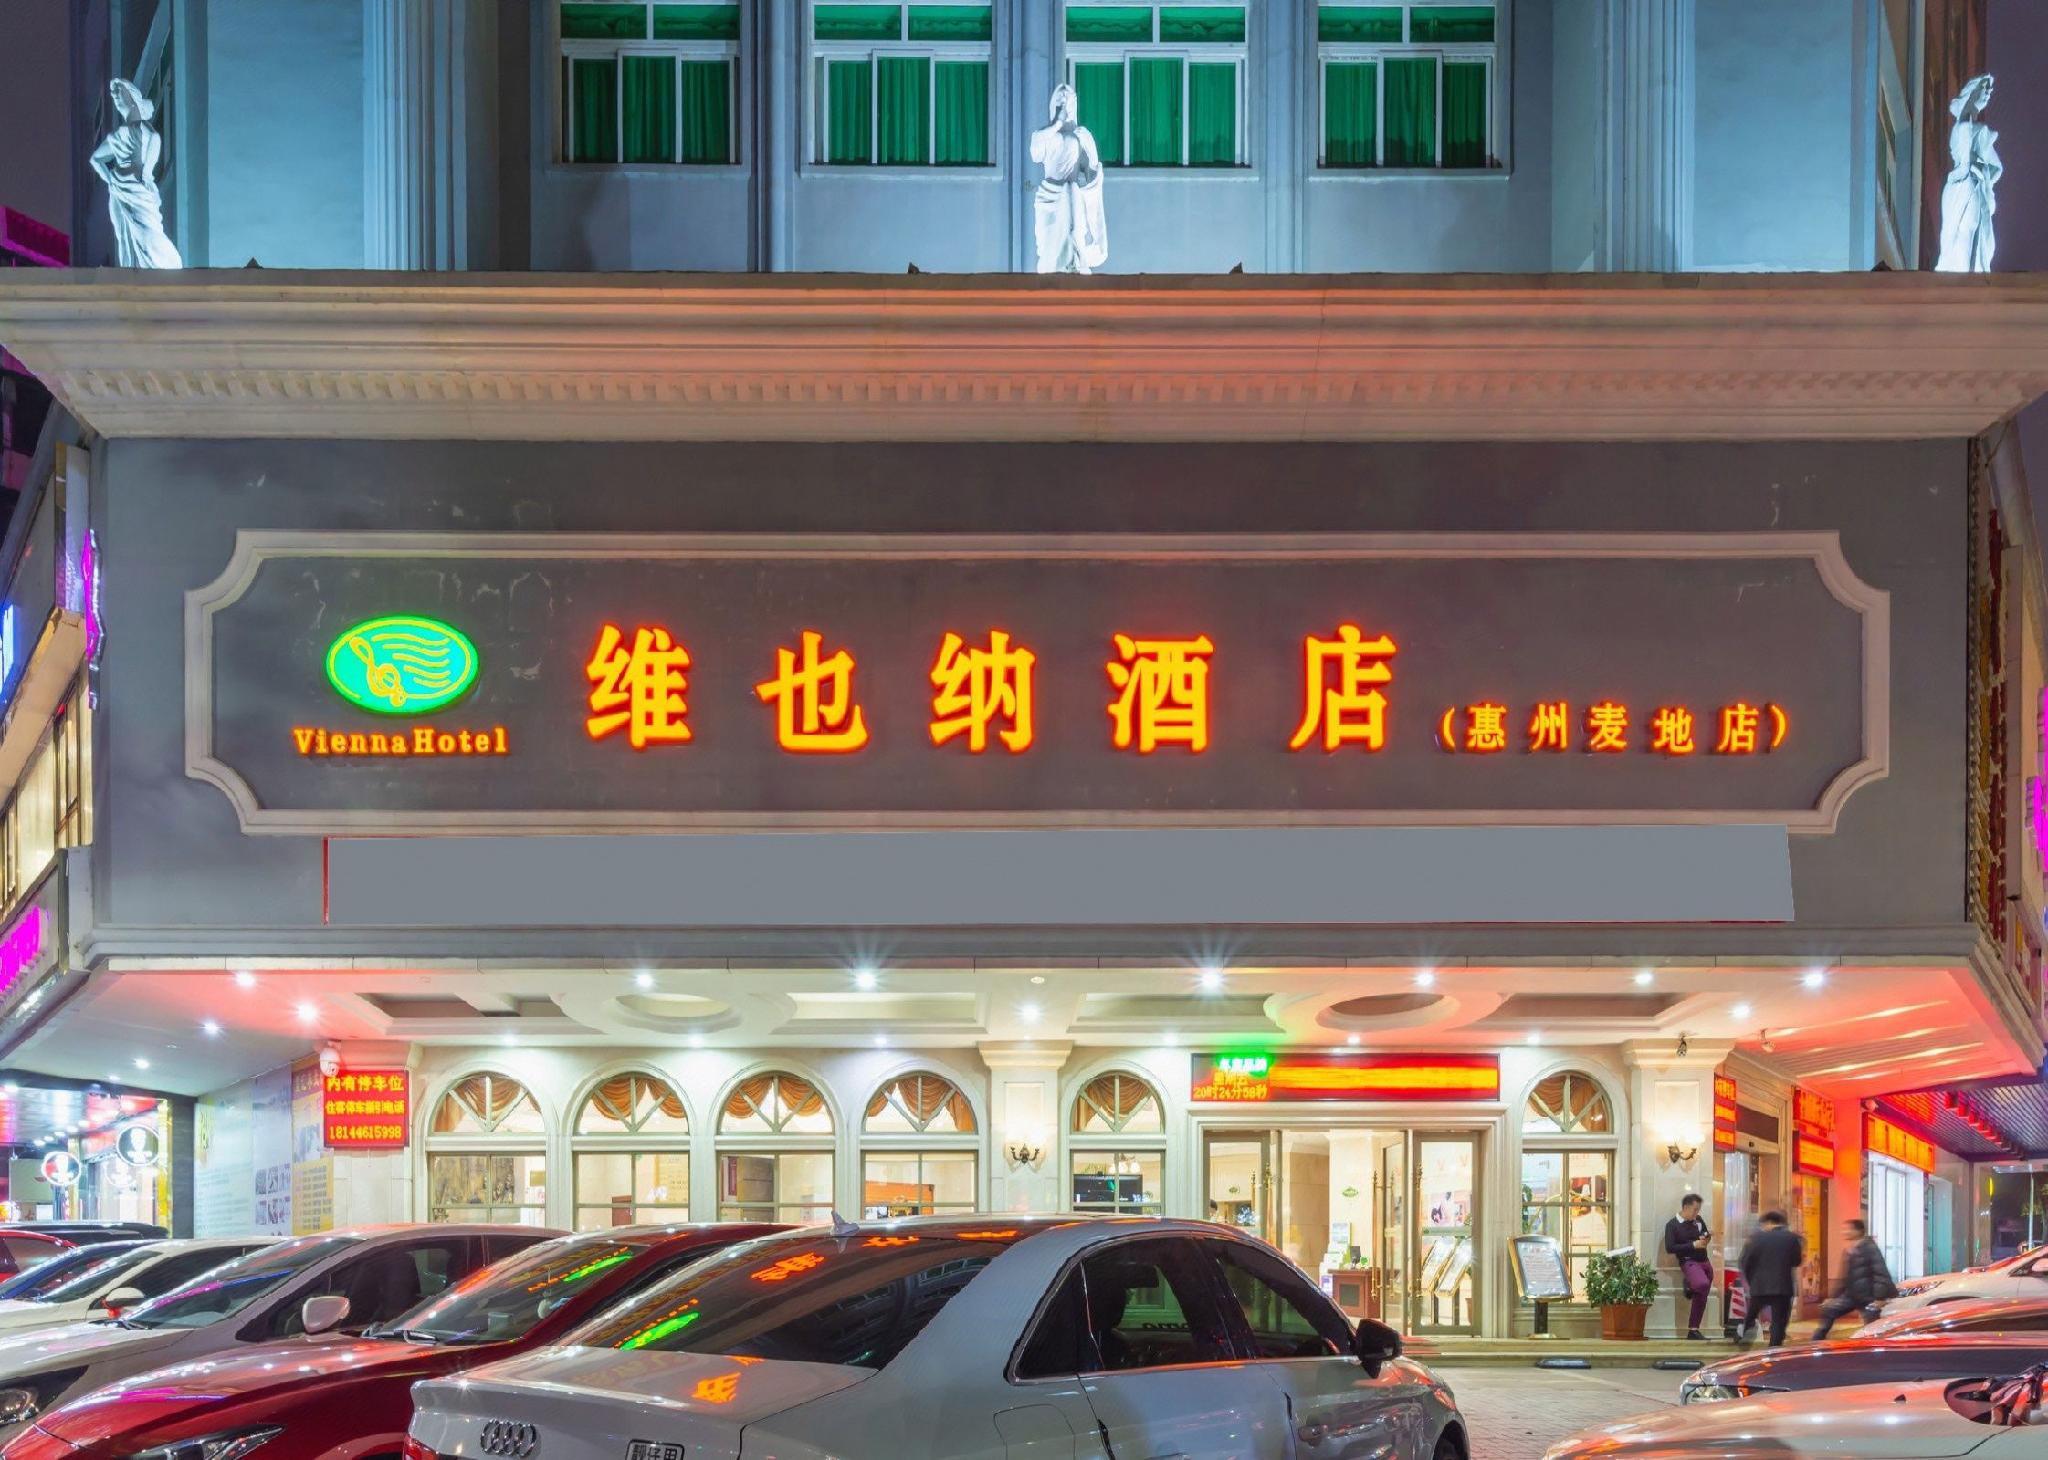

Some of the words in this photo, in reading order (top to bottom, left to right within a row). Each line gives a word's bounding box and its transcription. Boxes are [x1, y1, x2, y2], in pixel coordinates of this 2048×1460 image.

[586, 624, 1397, 752] 维也纳酒店
[293, 727, 407, 756] Vienna
[412, 727, 507, 756] Hotel
[329, 1125, 402, 1139] 18144615998
